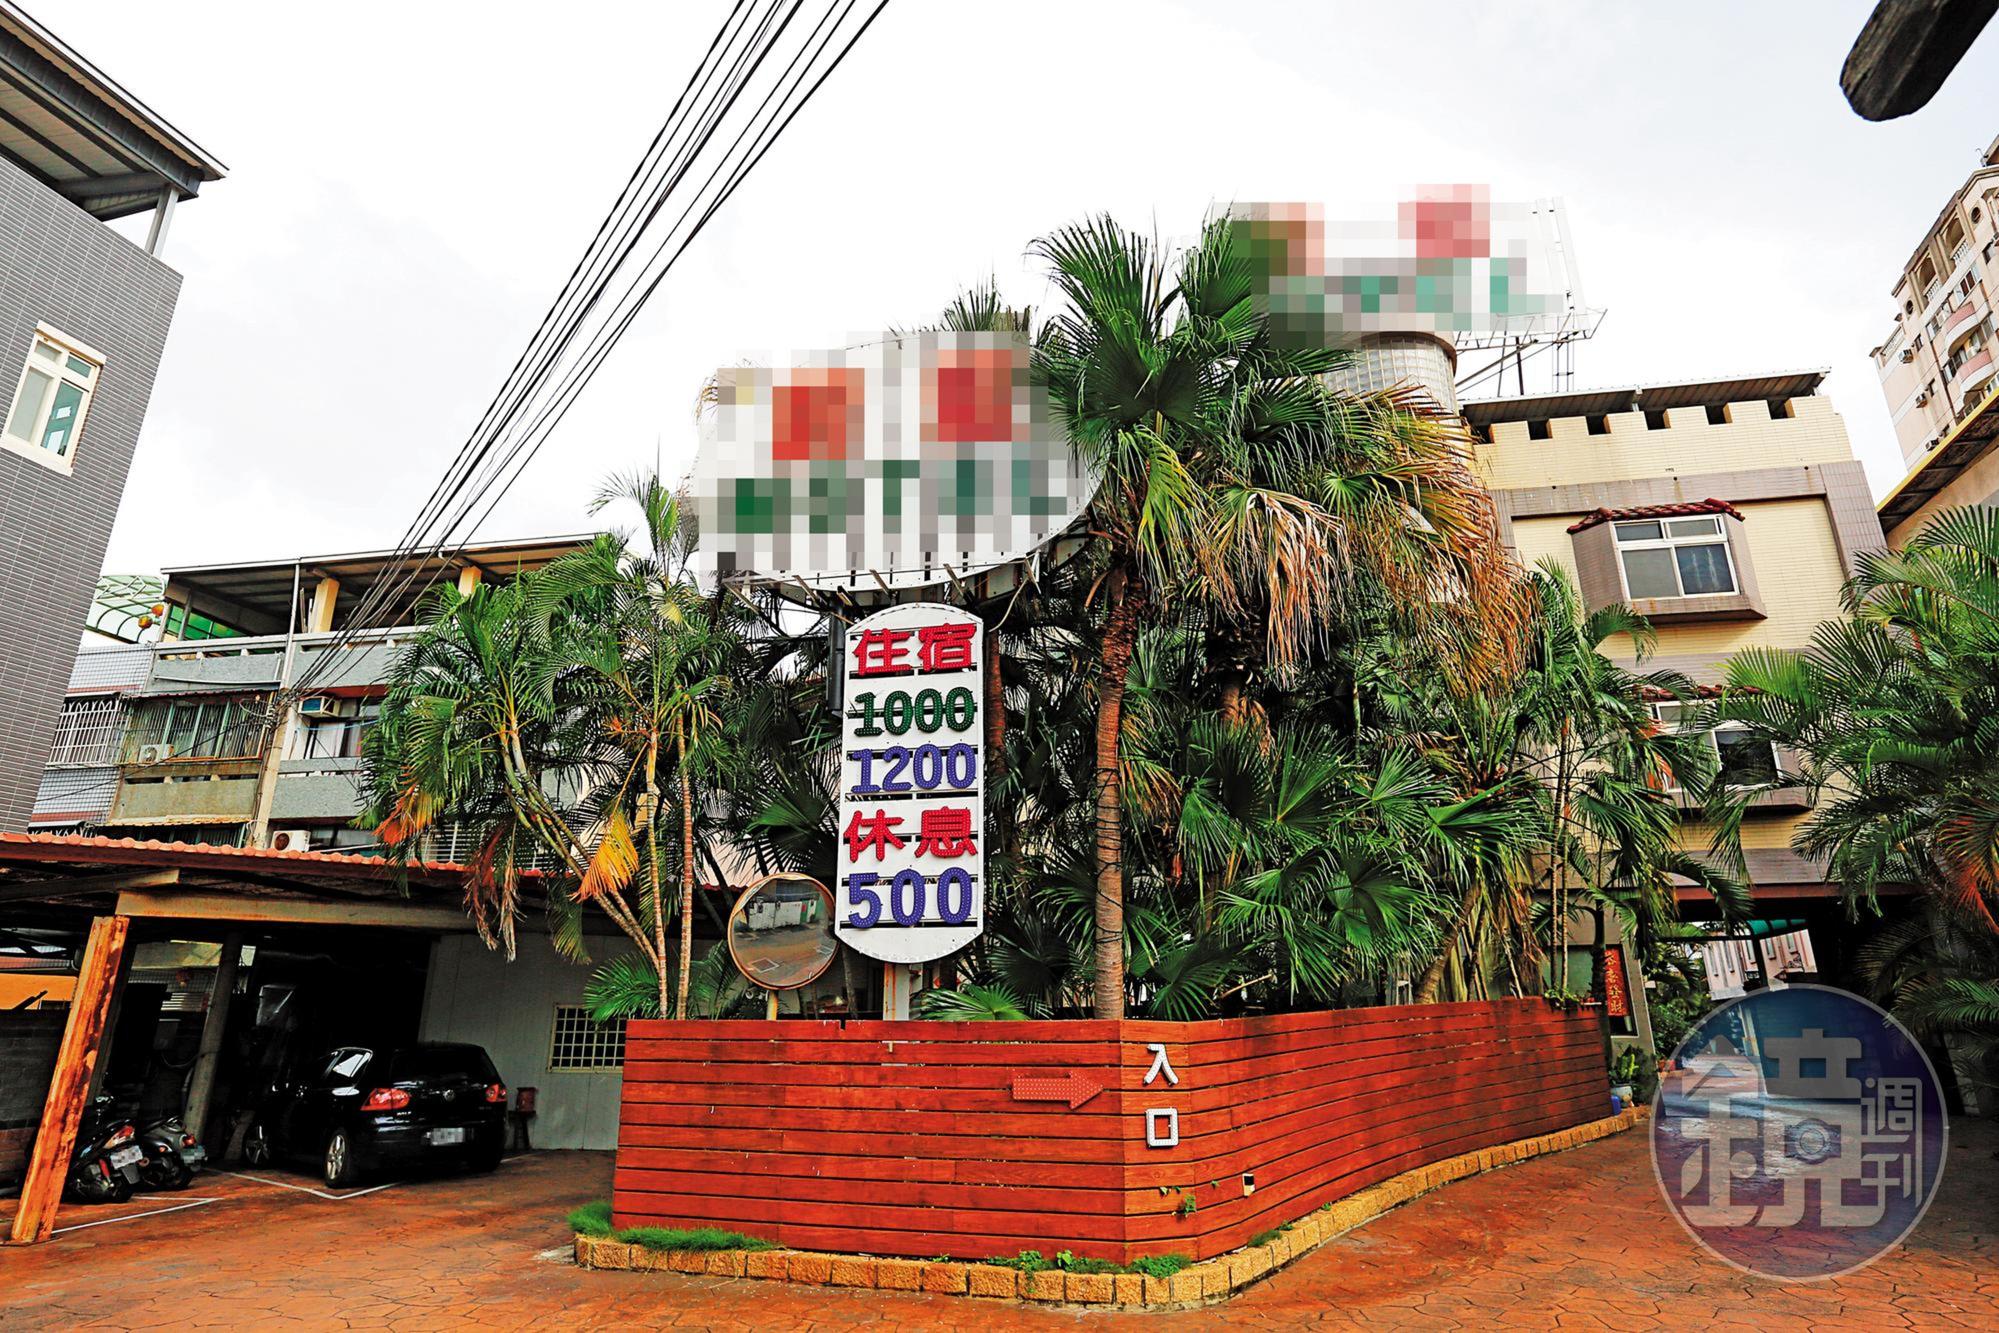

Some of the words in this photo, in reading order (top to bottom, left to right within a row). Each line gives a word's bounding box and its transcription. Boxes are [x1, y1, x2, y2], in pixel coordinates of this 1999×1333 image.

[853, 623, 977, 676] 住宿
[854, 687, 975, 736] 1000
[851, 743, 976, 794] 1200
[843, 807, 978, 862] 休息
[849, 867, 972, 929] 500
[1143, 1043, 1179, 1147] 入口
